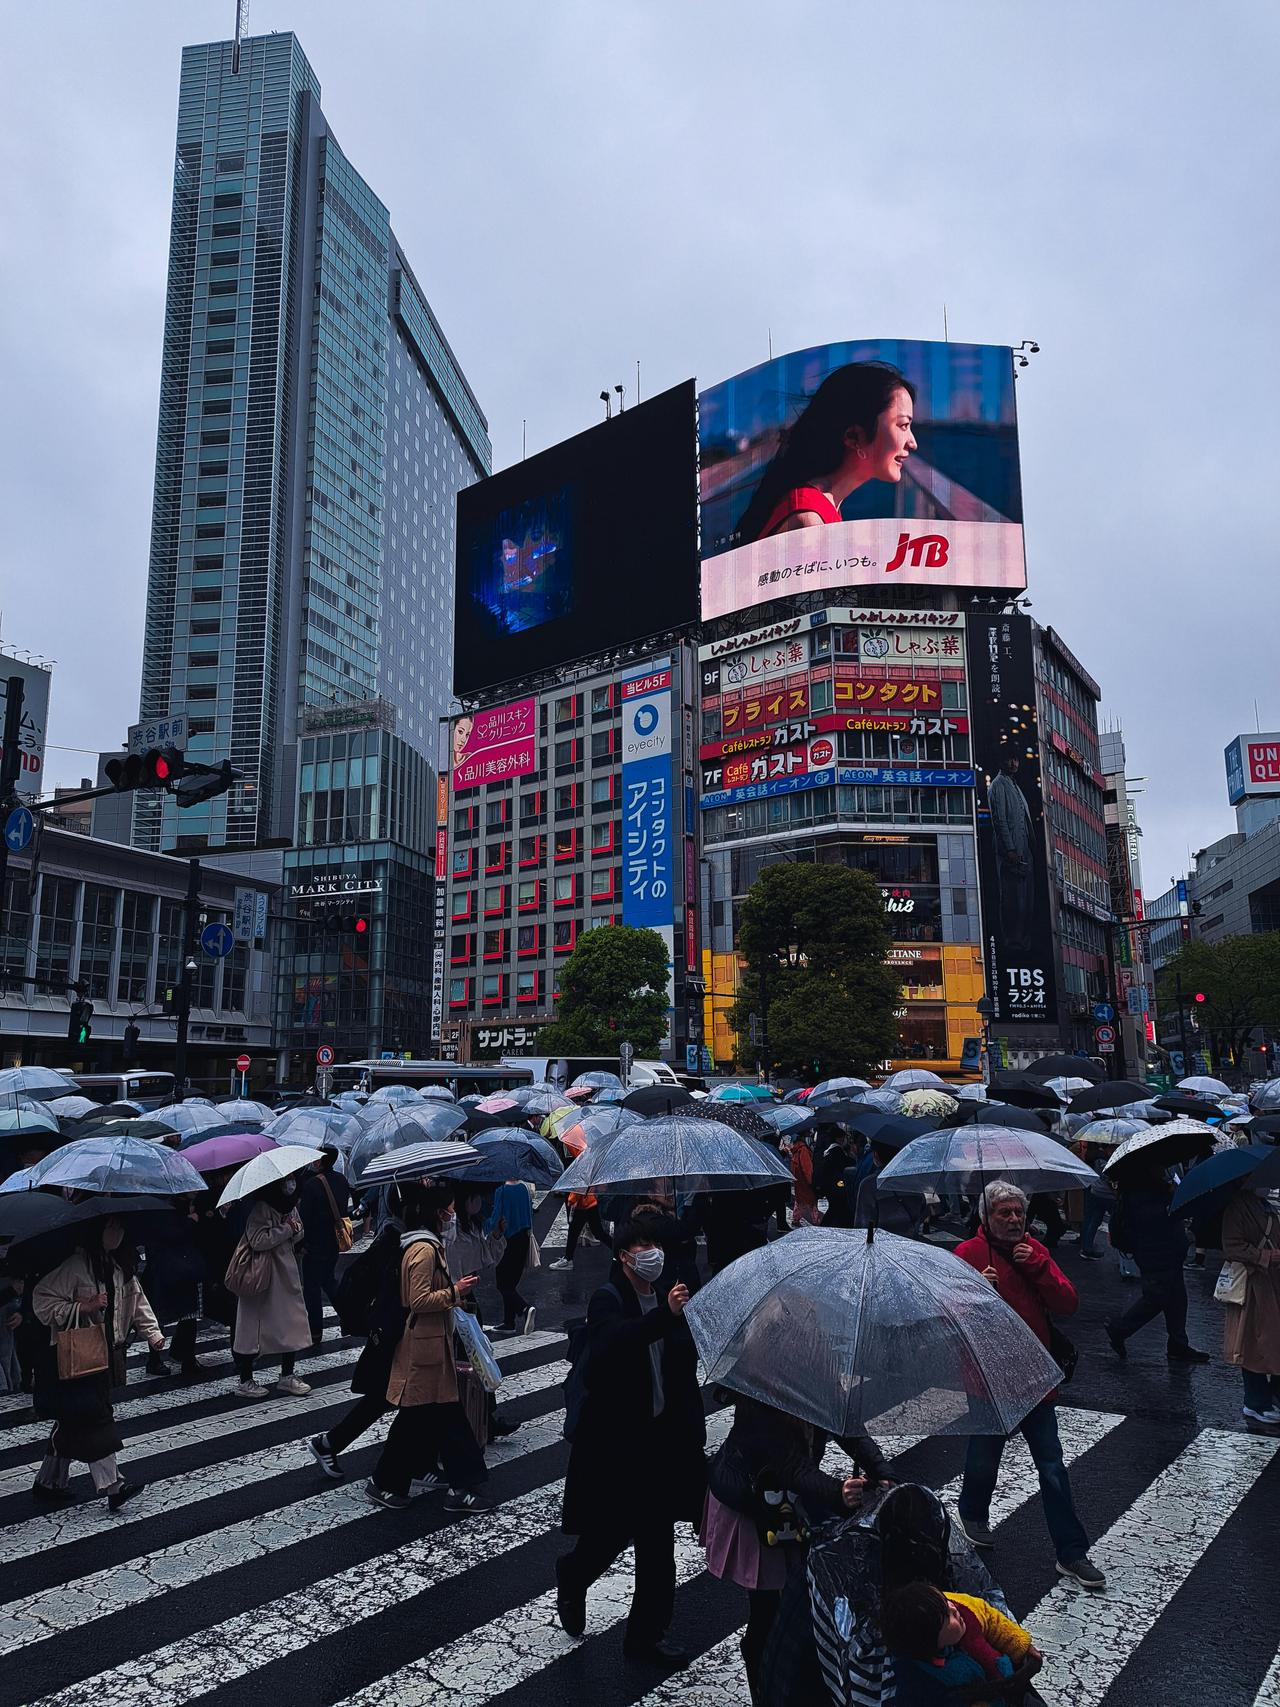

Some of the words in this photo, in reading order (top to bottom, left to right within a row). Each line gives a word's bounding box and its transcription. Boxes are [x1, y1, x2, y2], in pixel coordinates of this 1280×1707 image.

[885, 533, 949, 572] JTB
[757, 555, 877, 587] 感動のそばに、いつも。
[849, 609, 959, 625] しゃぶしゃぶバイキング
[710, 618, 801, 656] しゃぶしゃぶバイキング
[895, 634, 960, 655] しゃぶ葉
[751, 643, 803, 673] しゃぶ葉
[626, 674, 666, 695] 当ビル5F
[704, 671, 719, 685] 9F
[835, 682, 937, 703] コンタクト
[489, 707, 531, 728] 品川スキン
[724, 690, 807, 727] プライス
[133, 720, 183, 747] 渋谷駅前
[489, 721, 526, 741] クリニック
[775, 722, 816, 746] ガスト
[910, 717, 957, 735] ガスト
[628, 736, 666, 754] eyecity
[464, 751, 531, 781] 品川美容外科
[727, 762, 748, 777] Café
[750, 751, 803, 781] ガスト
[1255, 763, 1280, 779] QL
[704, 769, 722, 785] 7F
[844, 770, 874, 780] AEON
[882, 770, 972, 783] 英会話イーオン
[705, 793, 727, 804] AEON
[736, 776, 811, 800] 英会話イーオン
[815, 772, 829, 784] 6F
[628, 781, 649, 900] アイシティ
[651, 778, 667, 898] コンタクトの
[291, 883, 337, 895] MARK
[345, 879, 383, 890] CITY
[313, 873, 357, 883] SHIBUYA
[886, 949, 922, 959] CITANE
[1006, 968, 1045, 987] TBS
[1008, 988, 1046, 1003] ラジオ
[892, 1007, 908, 1018] afé
[451, 1031, 459, 1039] 2F
[478, 1028, 536, 1048] サンドラッ
